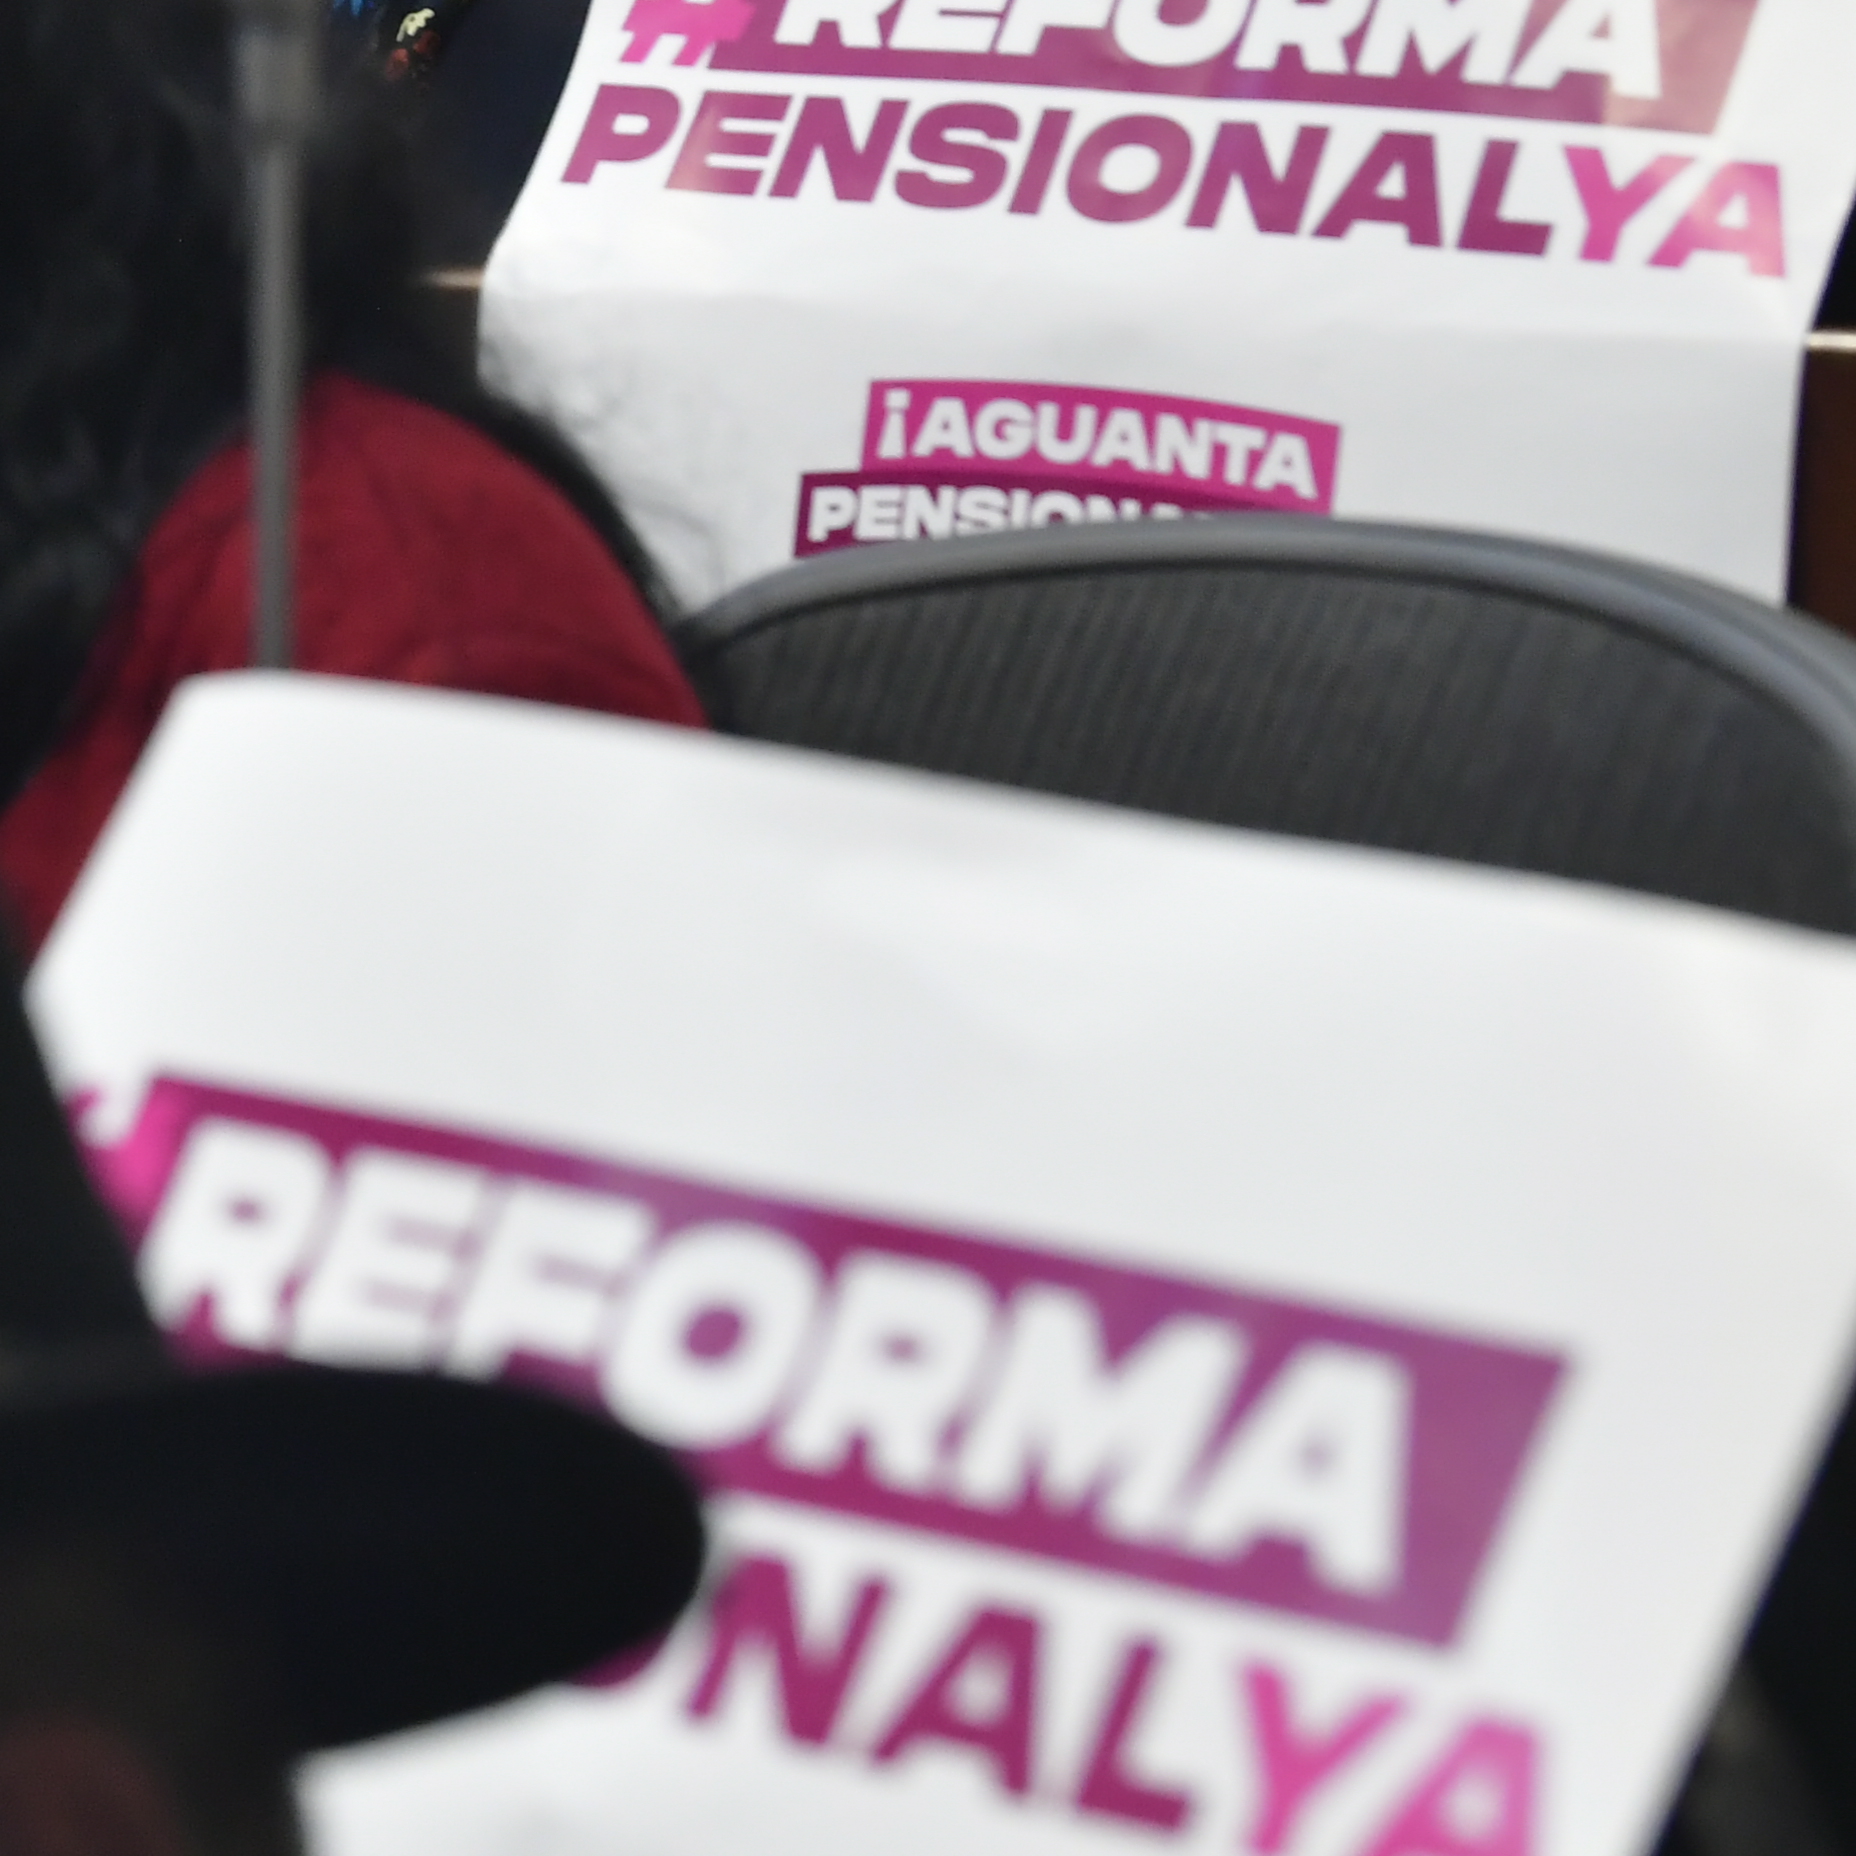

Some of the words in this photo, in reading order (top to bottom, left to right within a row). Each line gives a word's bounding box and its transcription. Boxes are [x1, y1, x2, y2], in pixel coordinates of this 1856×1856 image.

[561, 83, 1787, 278] PENSIONALYA
[876, 387, 1318, 500] ¡AGUANTA
[83, 1089, 1409, 1596] REFORMA
[603, 1554, 1535, 1856] NALYA
